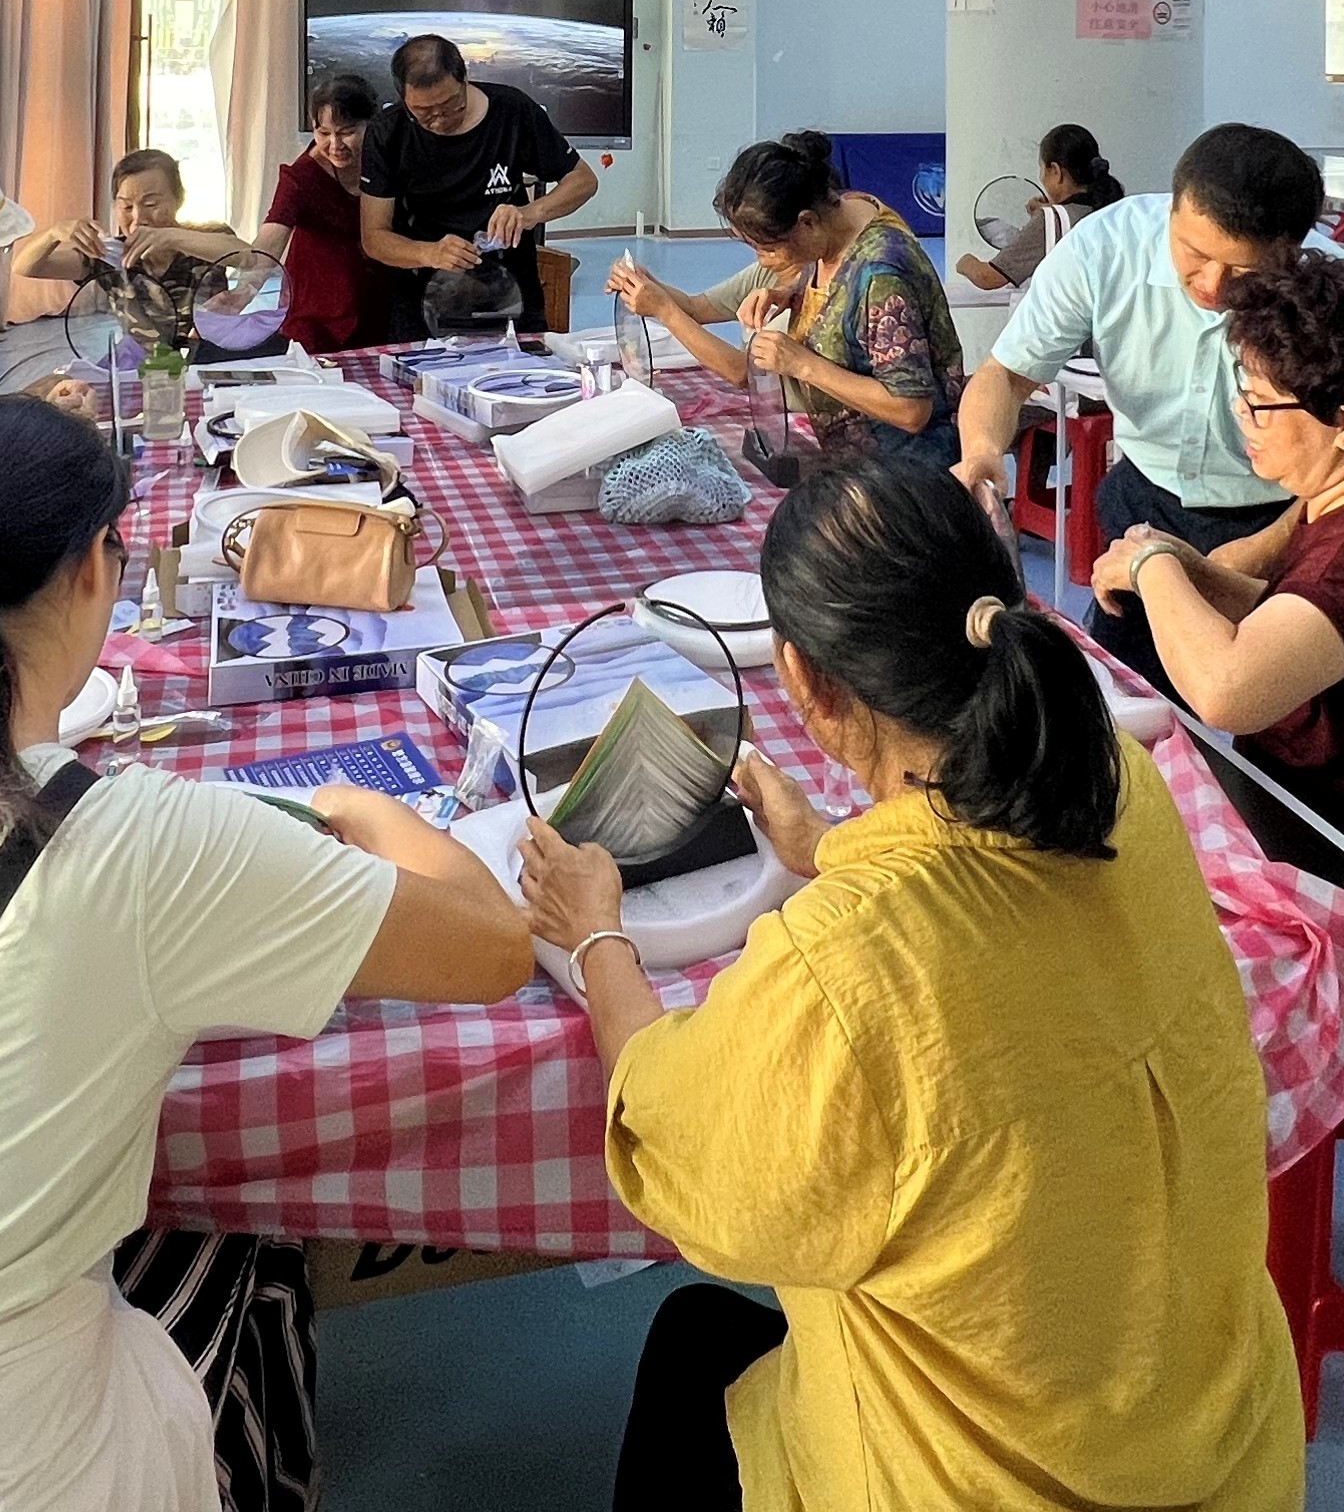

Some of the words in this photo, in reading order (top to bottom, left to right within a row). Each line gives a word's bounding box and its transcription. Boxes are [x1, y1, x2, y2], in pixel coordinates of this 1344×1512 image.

[264, 668, 325, 688] CHINA
[328, 666, 349, 683] IN
[353, 662, 407, 681] MADE
